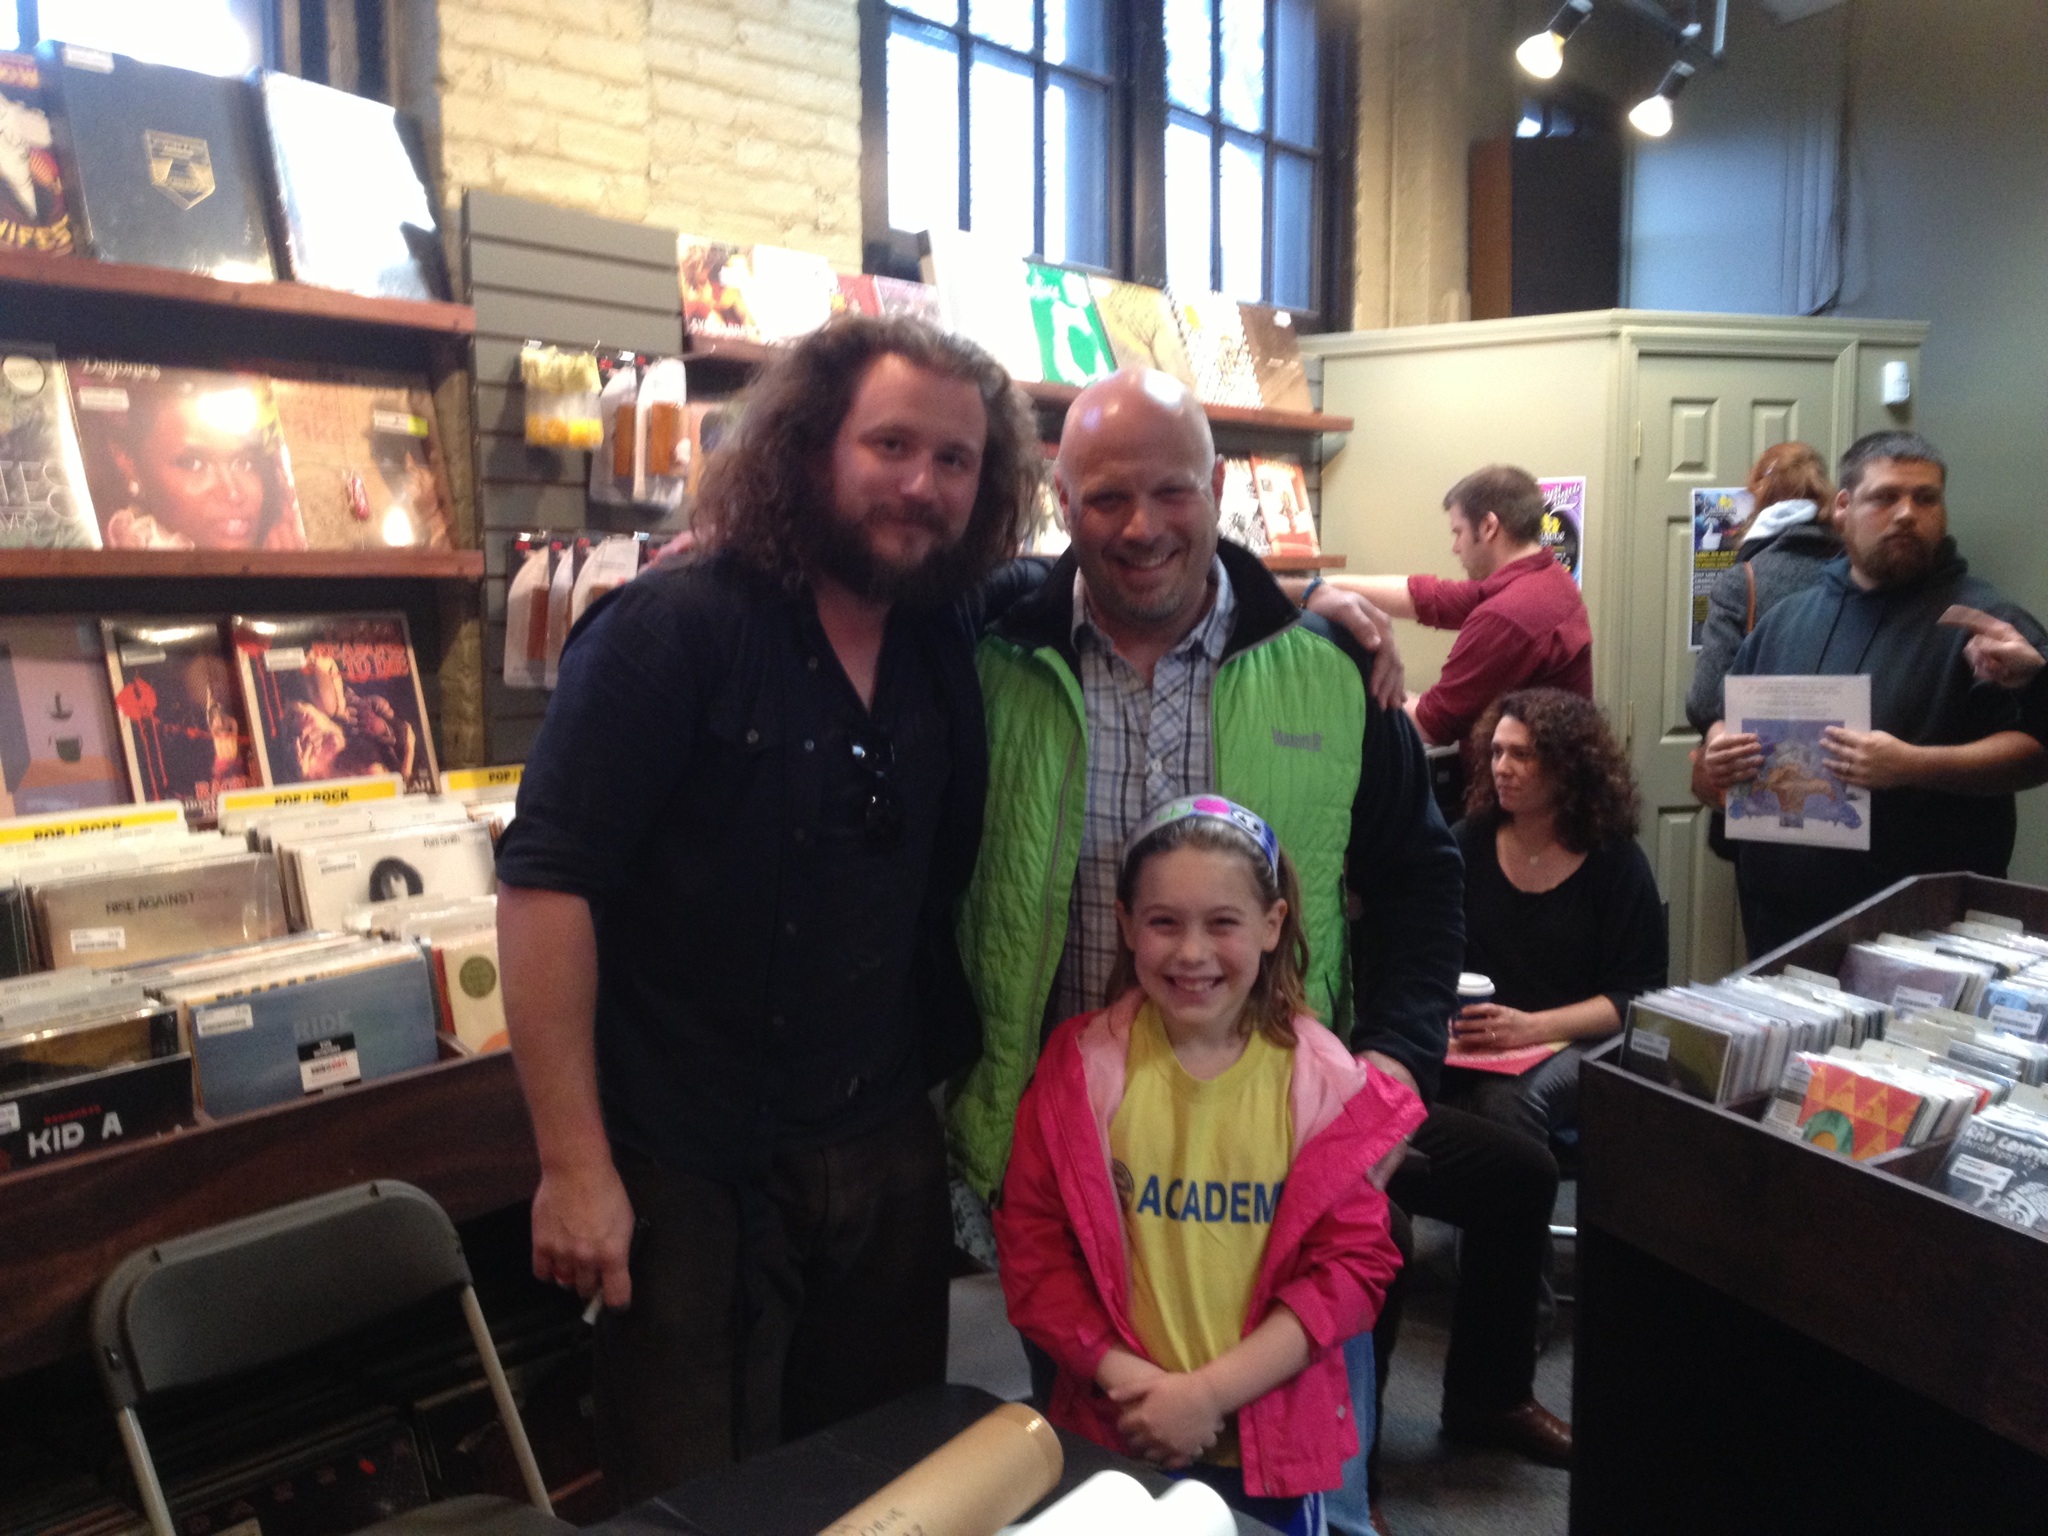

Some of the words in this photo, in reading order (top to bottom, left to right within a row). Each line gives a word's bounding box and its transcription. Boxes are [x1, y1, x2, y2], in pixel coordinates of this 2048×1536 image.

[312, 787, 351, 803] ROCK
[137, 888, 196, 913] AGAINST
[27, 1121, 85, 1159] KID
[101, 1110, 124, 1140] A
